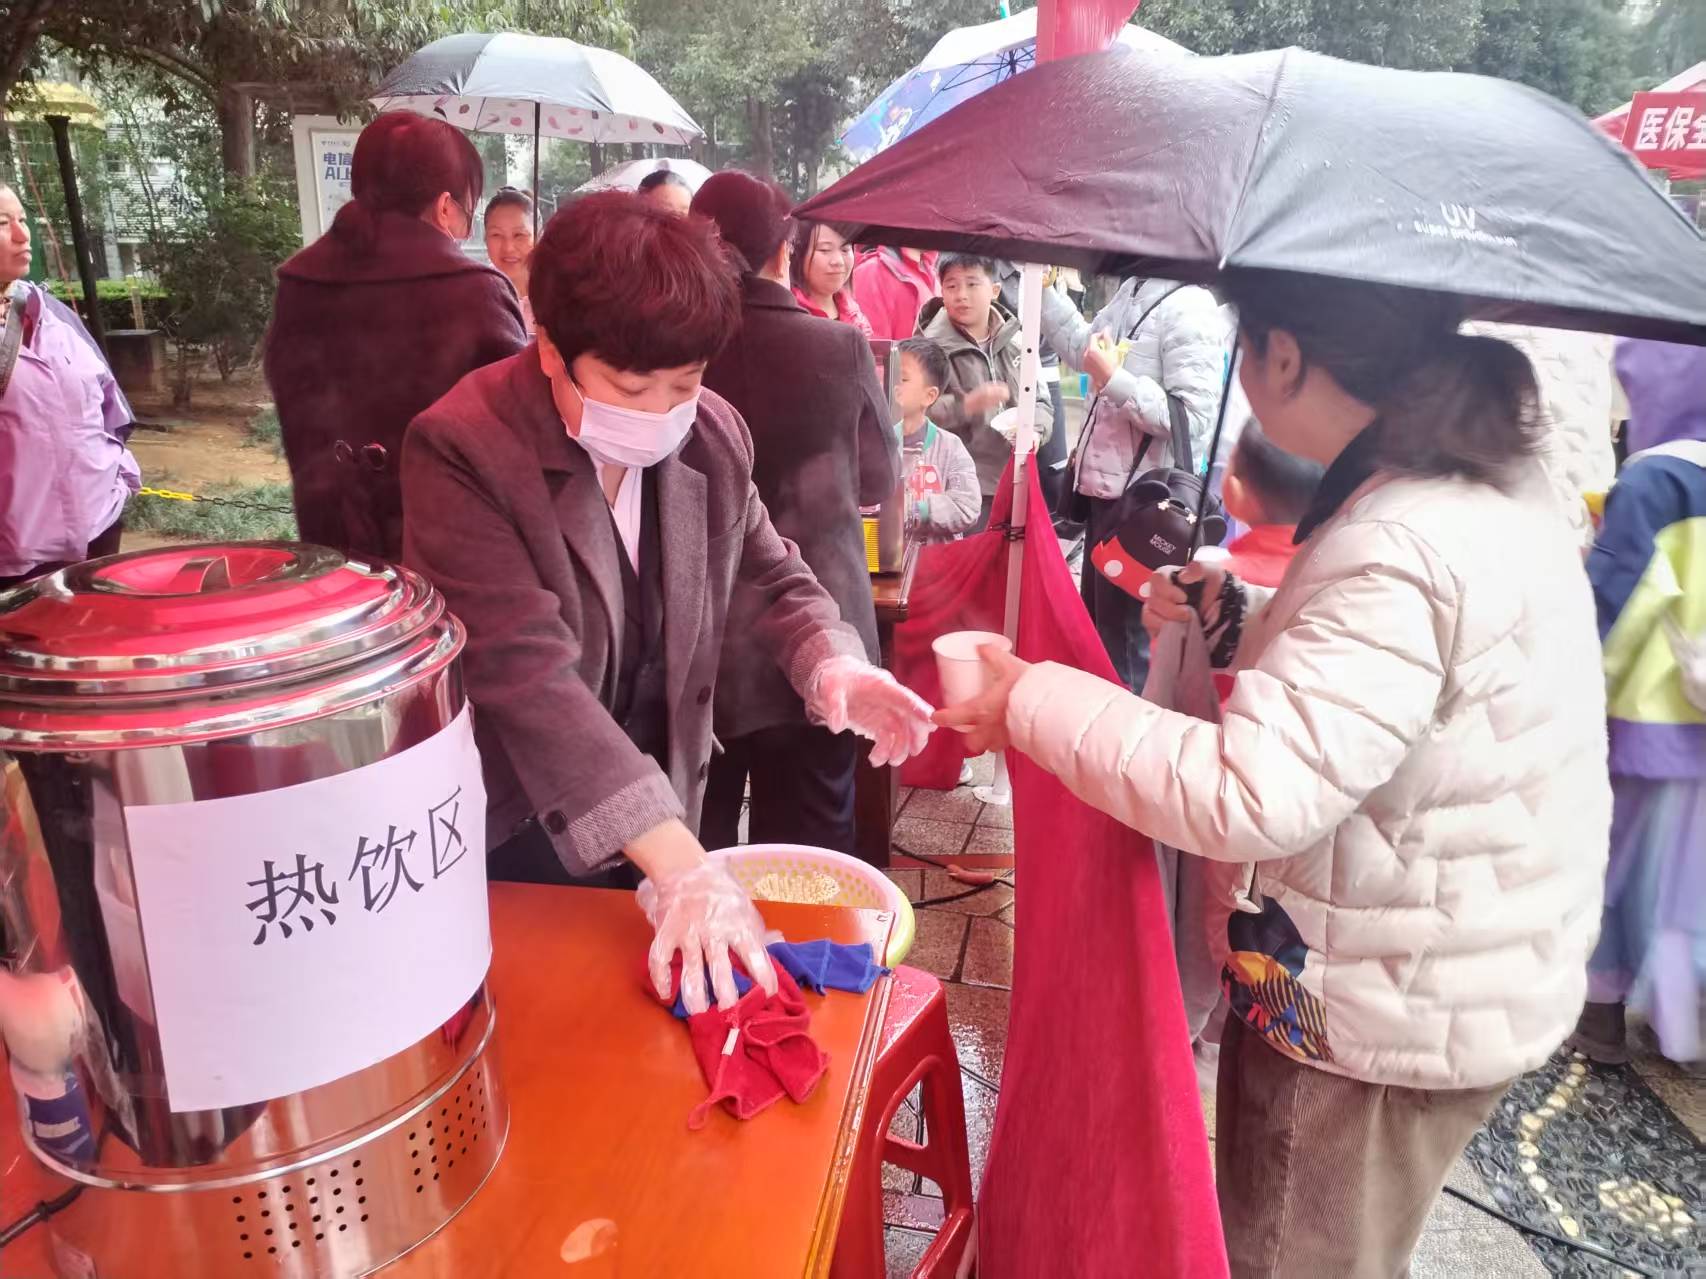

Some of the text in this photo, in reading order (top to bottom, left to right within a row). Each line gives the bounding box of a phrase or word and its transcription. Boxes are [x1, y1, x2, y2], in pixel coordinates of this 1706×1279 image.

[1440, 201, 1476, 230] UV
[1149, 538, 1171, 556] MOUSE
[1152, 533, 1177, 551] MICKEY
[245, 785, 468, 946] 热饮区
